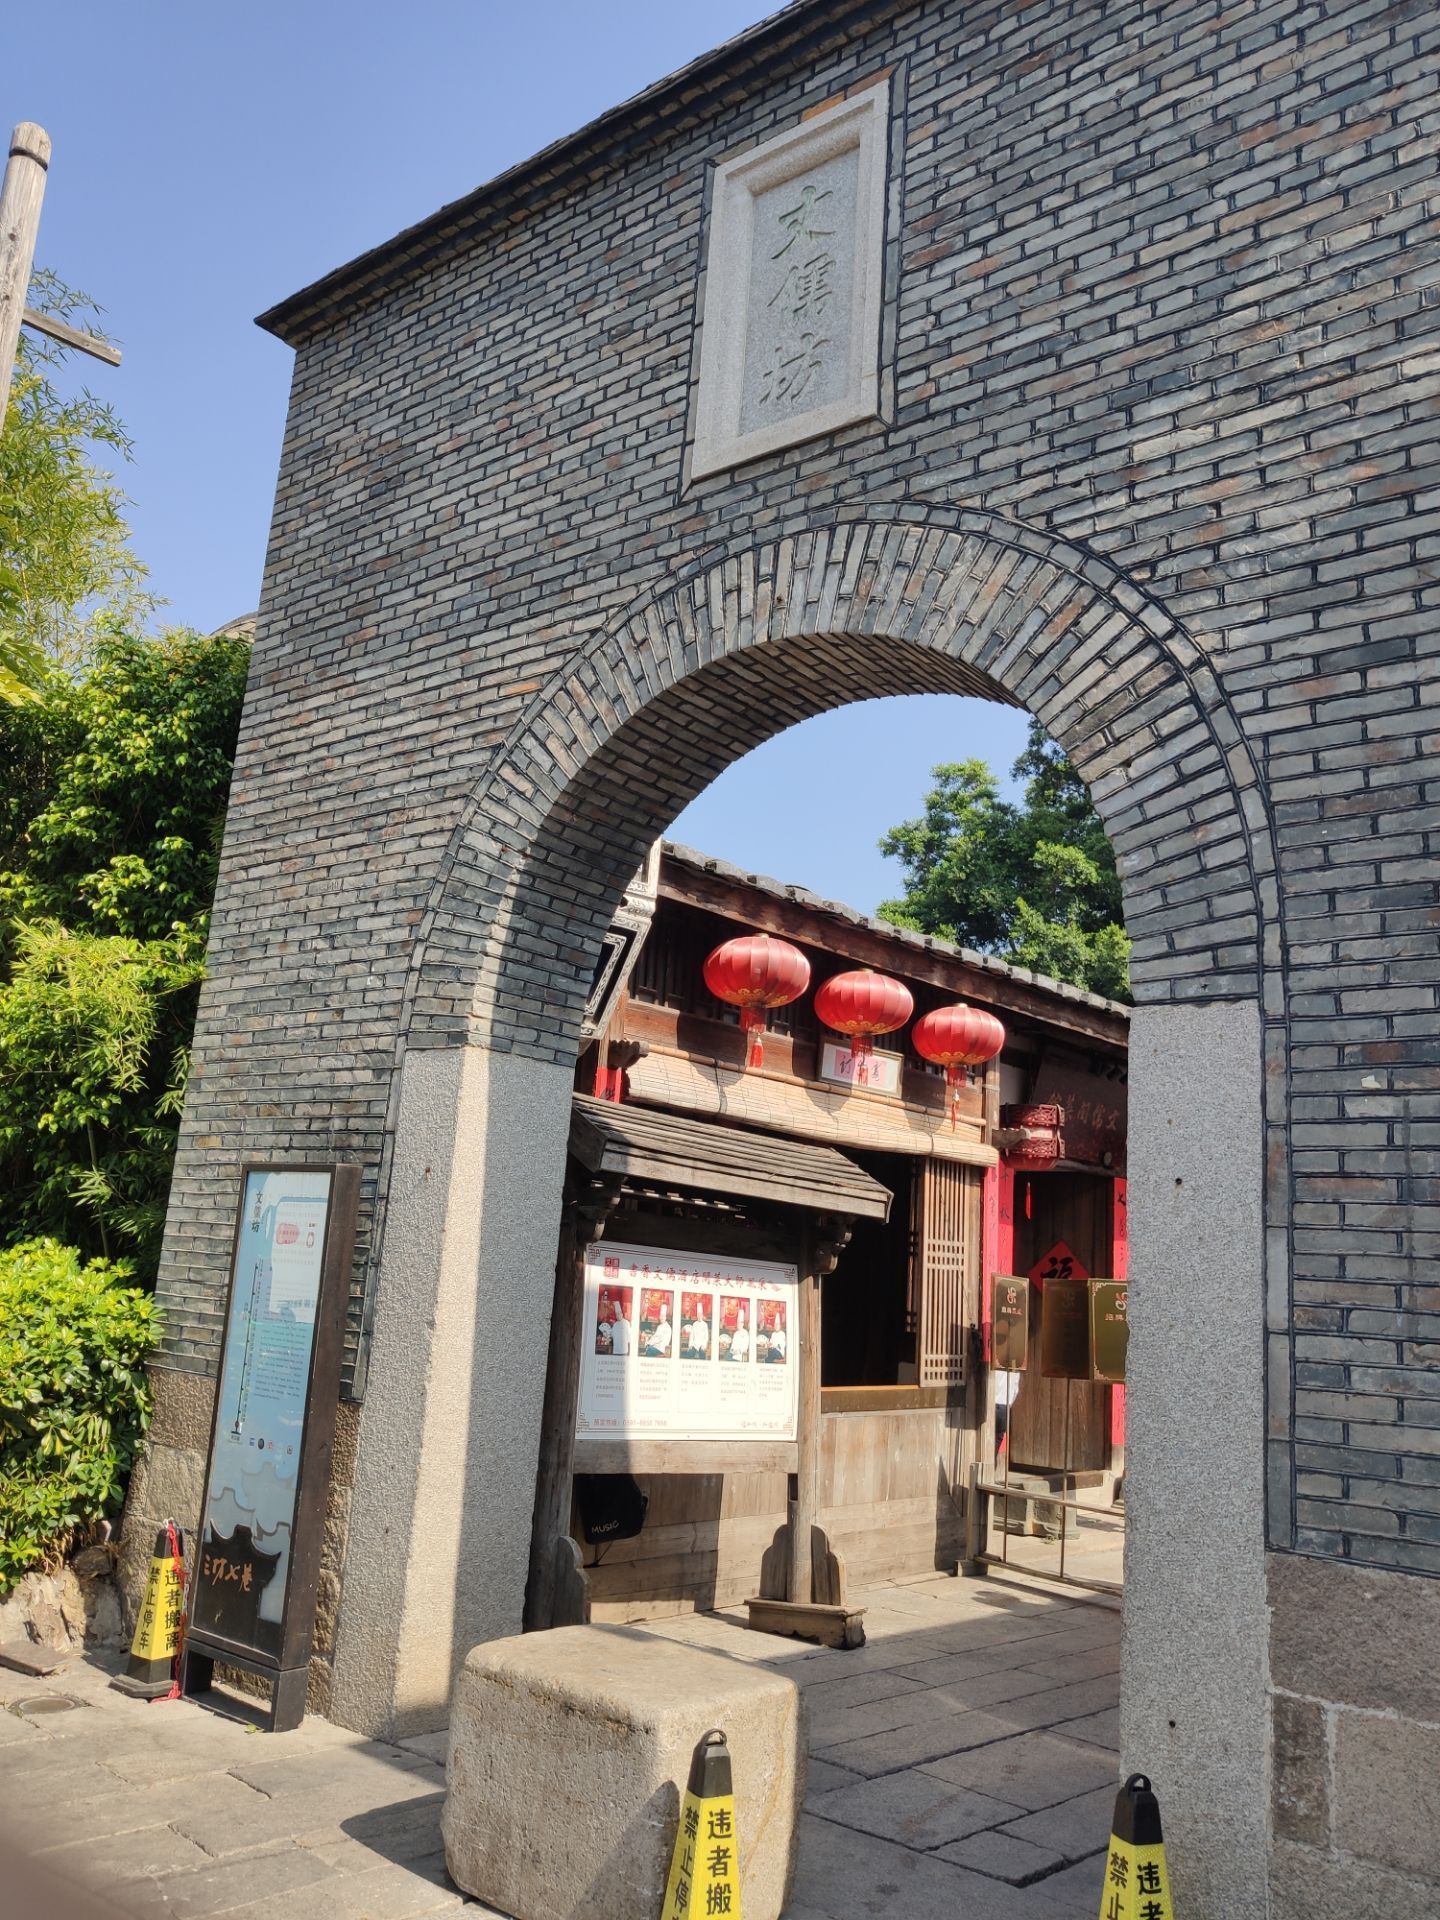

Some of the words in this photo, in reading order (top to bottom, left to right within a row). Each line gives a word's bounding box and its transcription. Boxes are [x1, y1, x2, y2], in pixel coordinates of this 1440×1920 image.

[759, 184, 837, 402] 文儒坊
[591, 1519, 620, 1534] MUSIC
[139, 1566, 161, 1651] 禁止停车
[164, 1569, 182, 1651] 违者搬离
[671, 1806, 700, 1920] 禁止停
[706, 1808, 733, 1916] 违者搬
